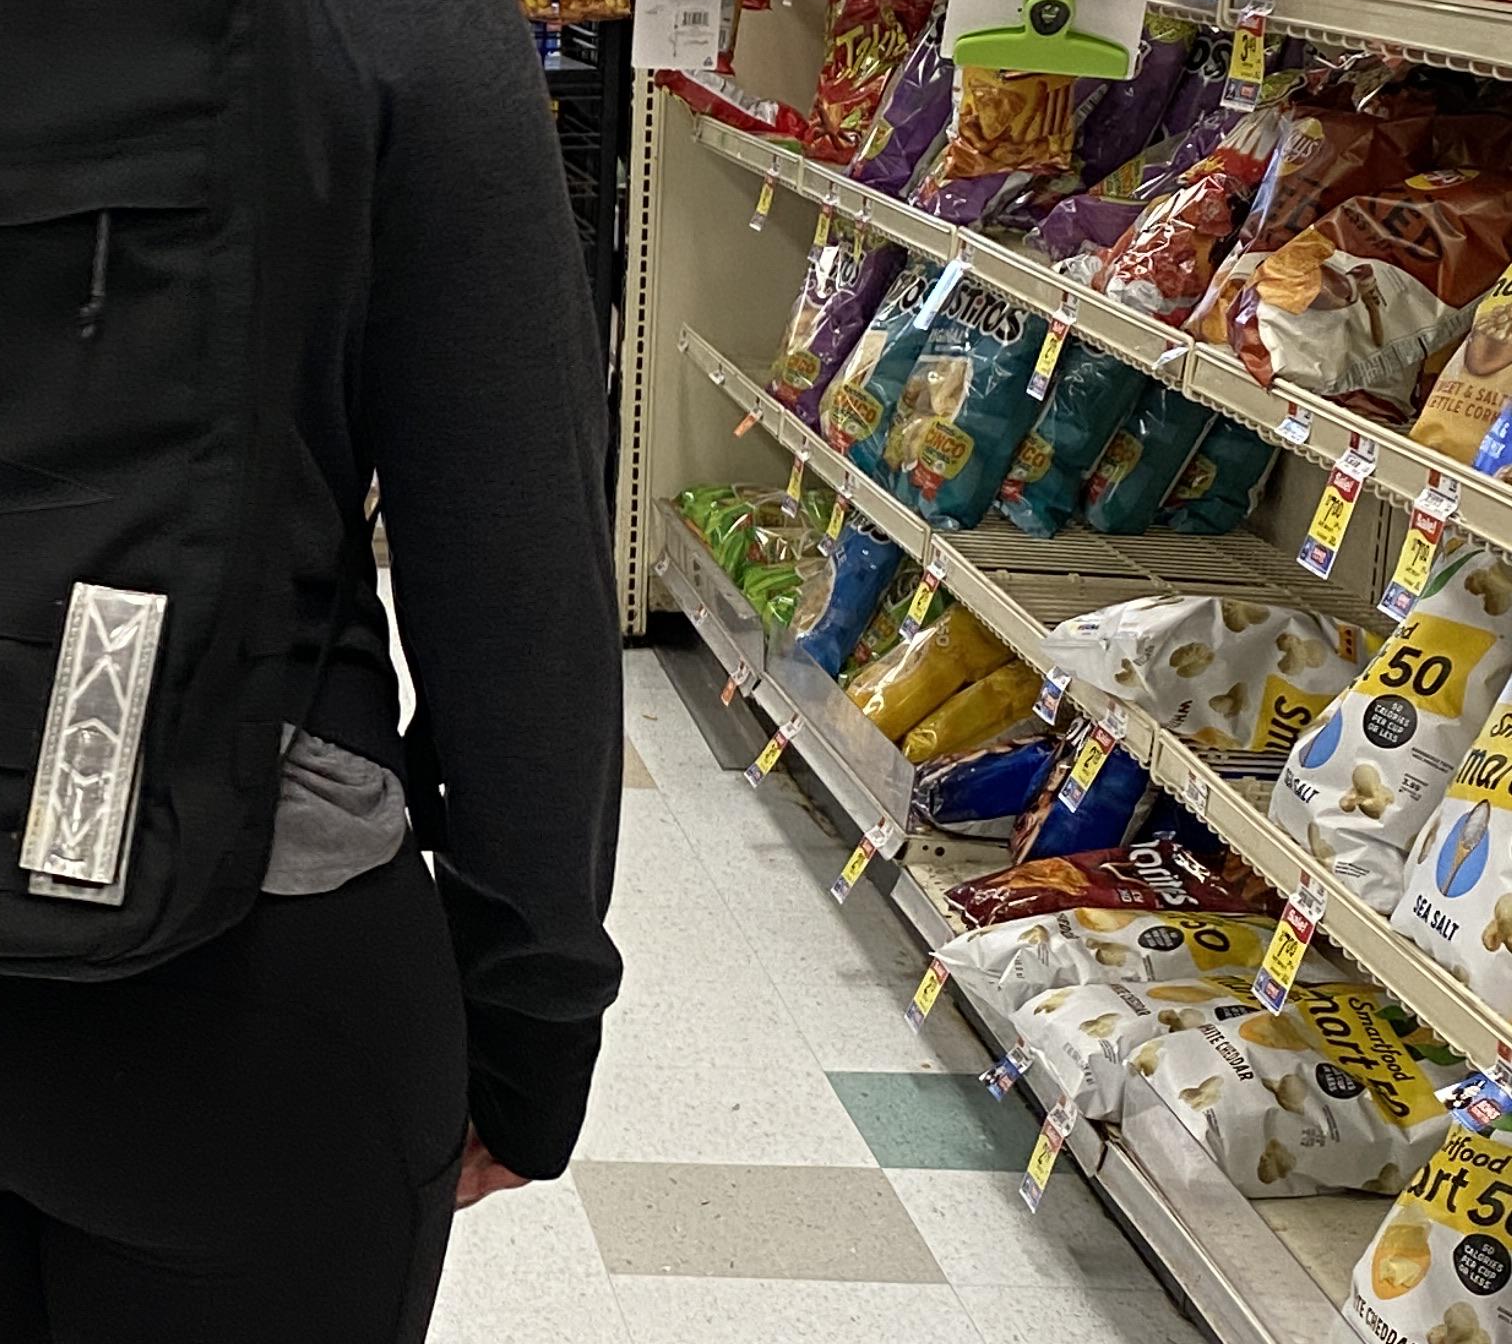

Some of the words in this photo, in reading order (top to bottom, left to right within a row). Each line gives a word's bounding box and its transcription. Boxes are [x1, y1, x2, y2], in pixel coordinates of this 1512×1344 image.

[1379, 644, 1453, 698] 50
[1293, 776, 1322, 804] SALT
[1412, 895, 1433, 924] SEA
[1428, 909, 1460, 942] SALT
[1349, 995, 1416, 1084] Smartfood
[1407, 1161, 1470, 1214] art
[1463, 1243, 1505, 1273] CALORIES
